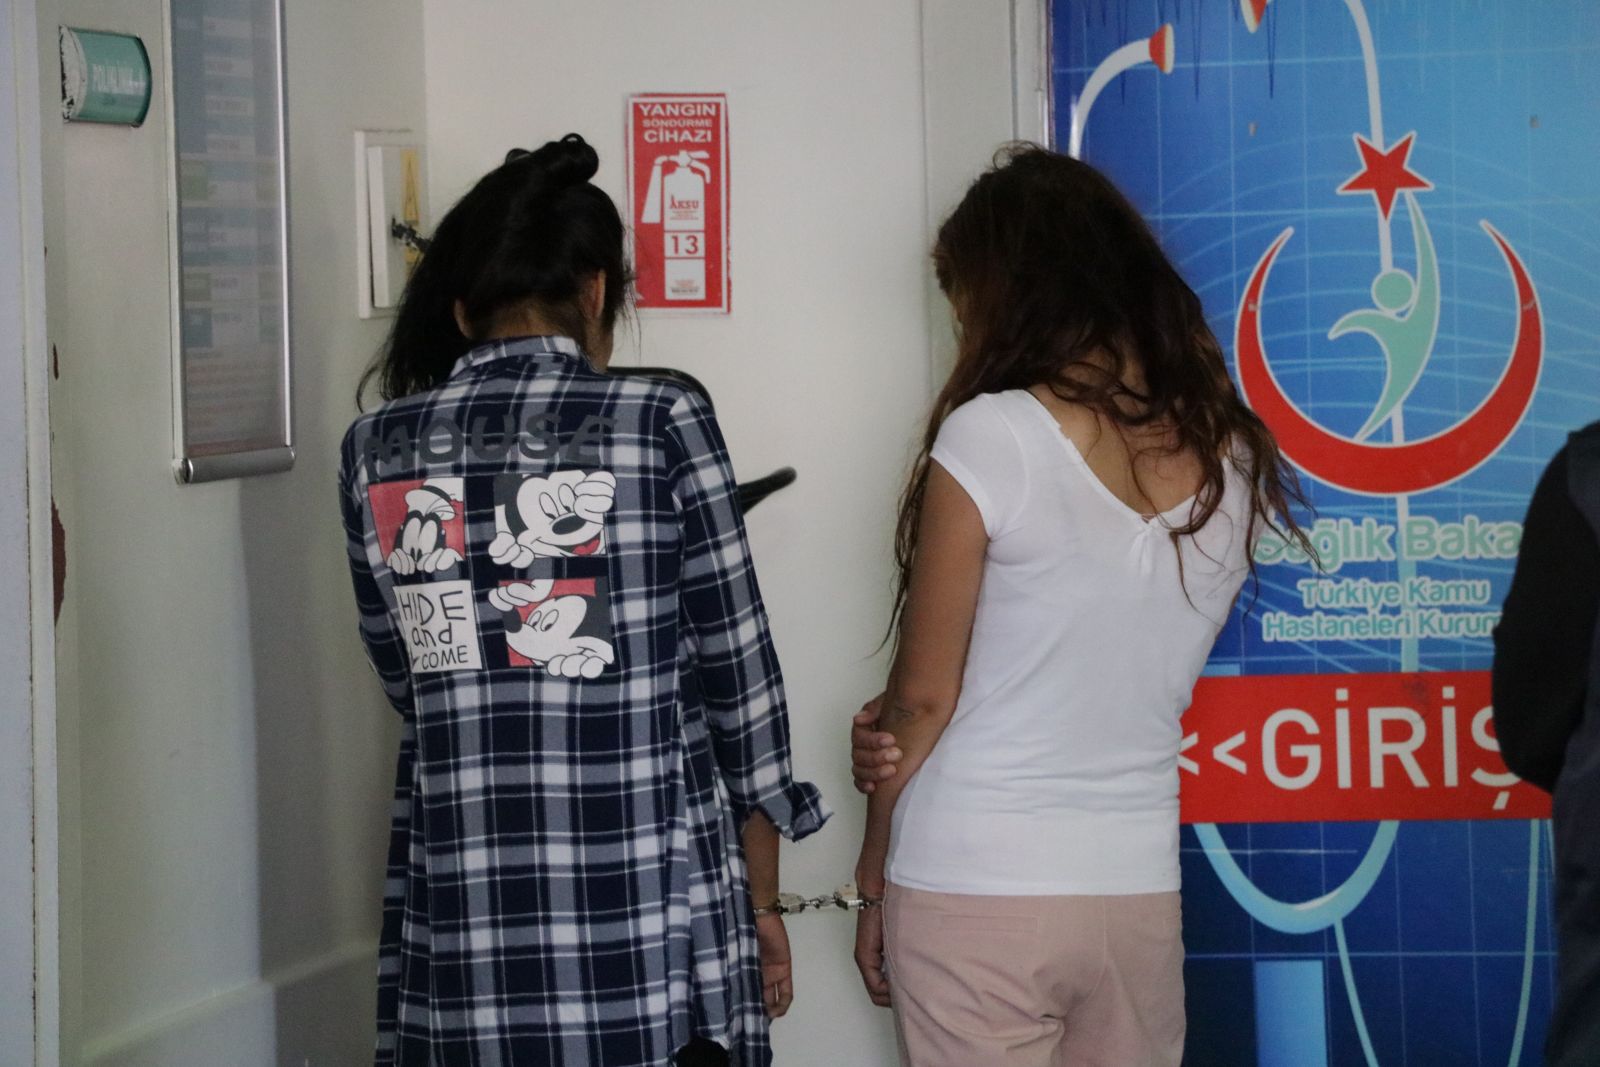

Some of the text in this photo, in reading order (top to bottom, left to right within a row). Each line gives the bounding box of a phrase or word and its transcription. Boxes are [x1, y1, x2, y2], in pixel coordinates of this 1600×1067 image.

[639, 103, 716, 117] YANGIN
[643, 127, 712, 143] CİHAZI
[671, 235, 698, 255] 13
[363, 411, 617, 484] MOUSE
[399, 590, 467, 625] HIDE
[1298, 576, 1491, 612] Türkiye Kamu
[411, 621, 453, 648] and
[1263, 611, 1413, 642] Hastaneleri
[1261, 685, 1522, 811] GİRİŞ
